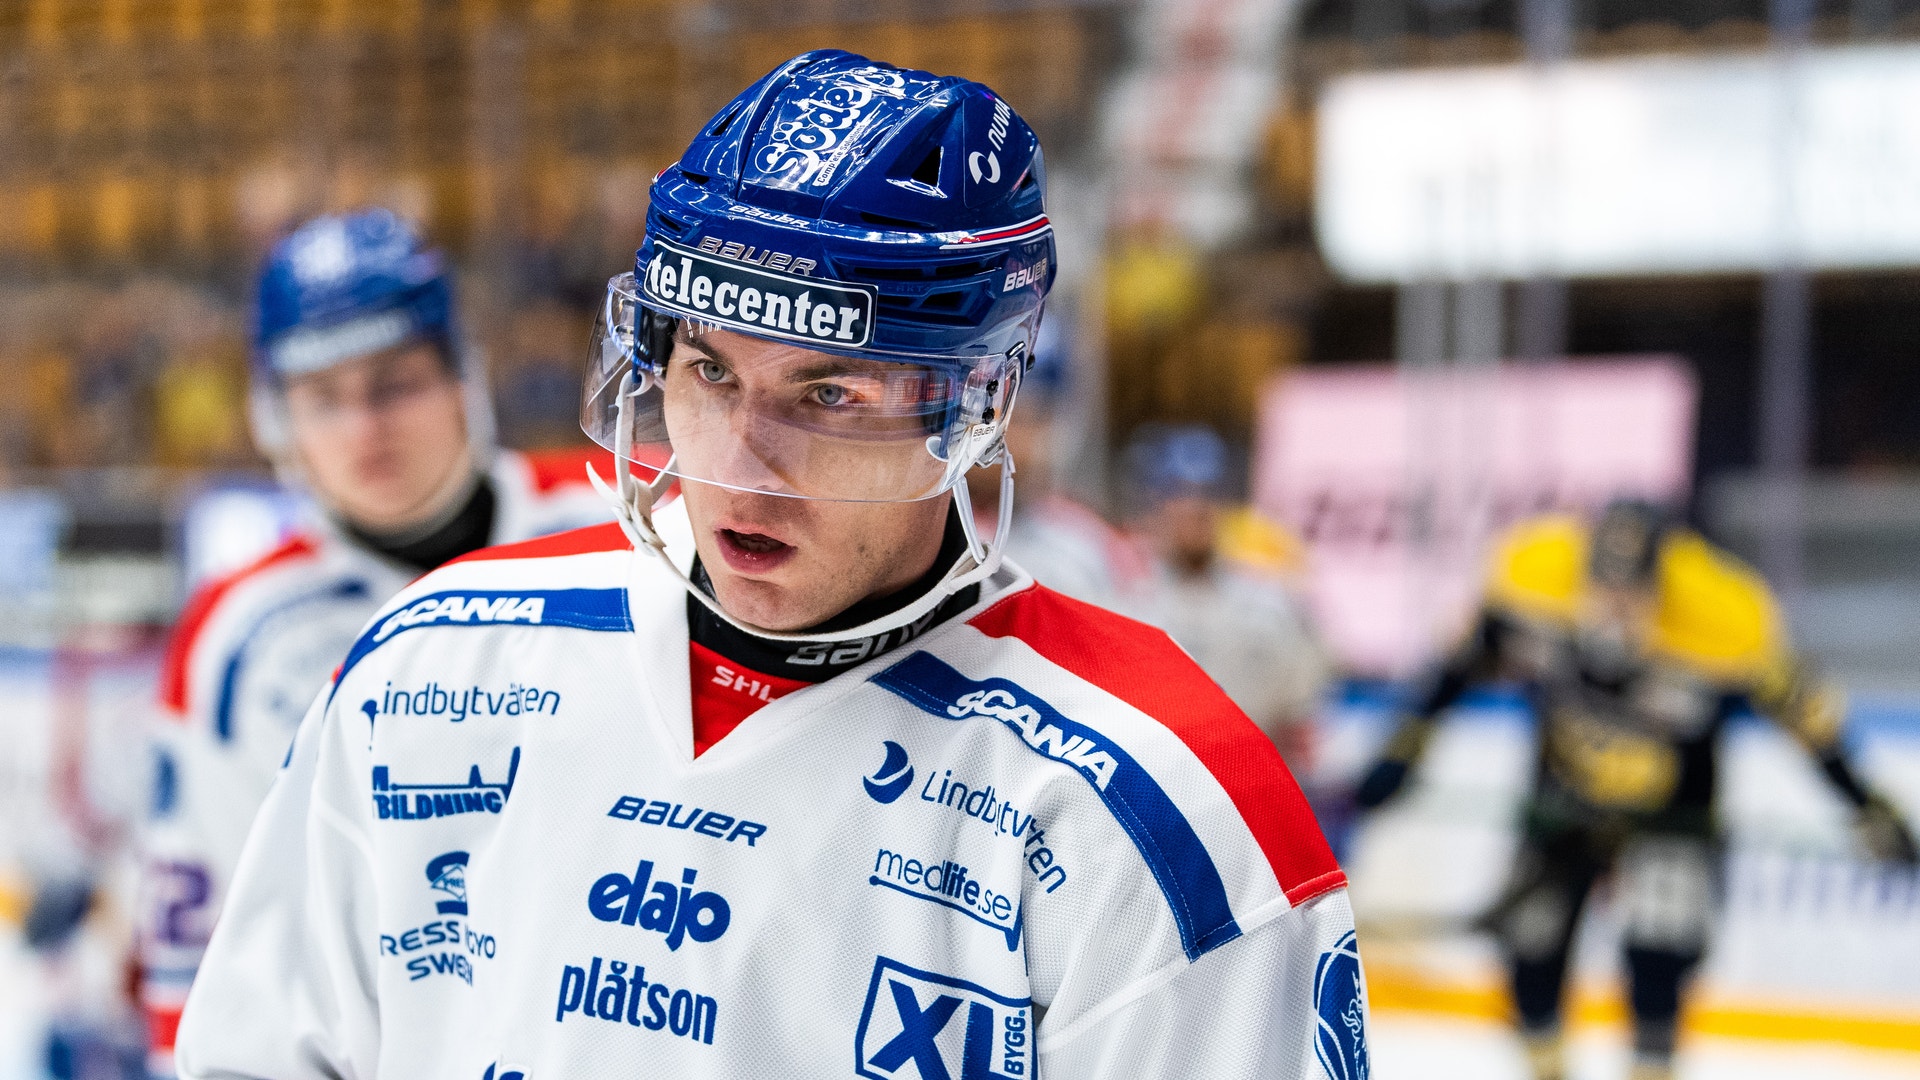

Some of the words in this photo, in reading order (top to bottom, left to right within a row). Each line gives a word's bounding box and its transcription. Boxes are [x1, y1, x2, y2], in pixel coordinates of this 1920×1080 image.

[728, 204, 811, 230] BAUER
[699, 235, 818, 277] BAUER
[1002, 257, 1047, 293] BAUER
[650, 251, 861, 340] telecenter
[372, 596, 546, 642] SCANIA
[947, 689, 1119, 792] SCANIA
[373, 791, 502, 820] BILDNING
[607, 795, 767, 847] BAUER
[588, 860, 731, 952] elajo
[875, 848, 1012, 921] medlife.se
[380, 920, 460, 956] RESS
[556, 957, 718, 1045] plåtson
[867, 978, 1020, 1080] XL
